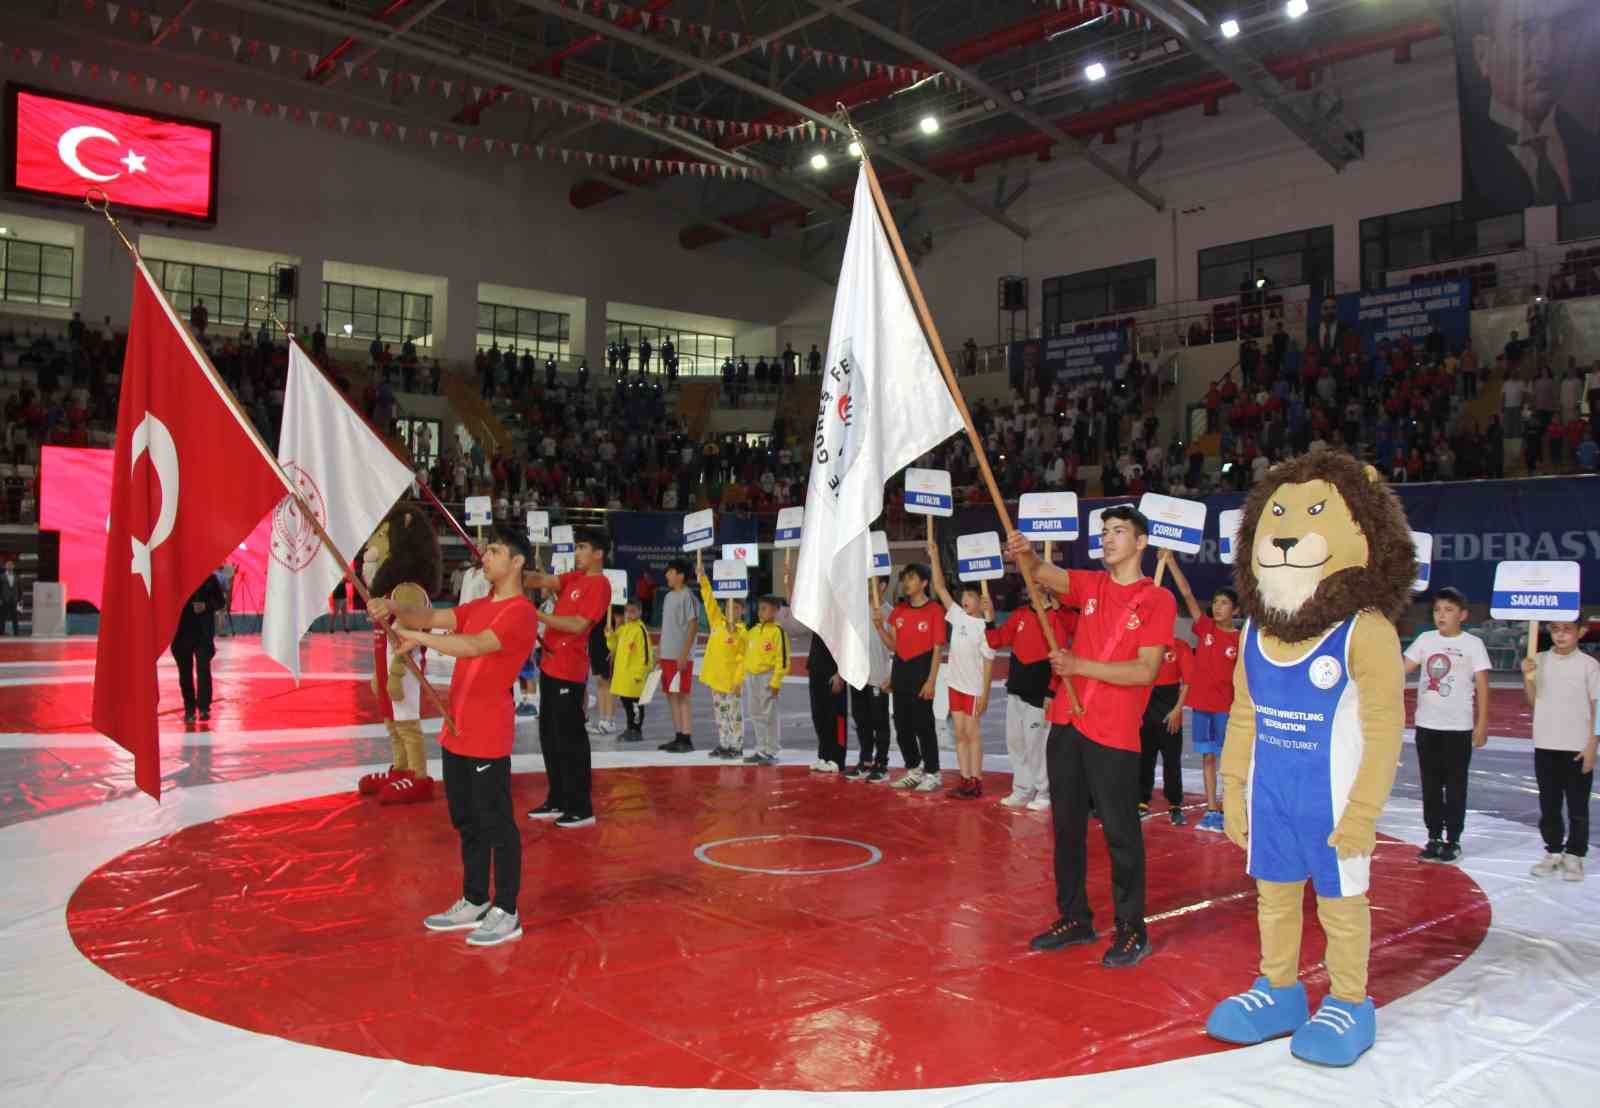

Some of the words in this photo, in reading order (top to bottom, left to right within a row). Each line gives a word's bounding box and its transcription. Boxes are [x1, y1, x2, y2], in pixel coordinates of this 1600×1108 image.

[915, 493, 941, 506] ANTALYA
[1031, 519, 1063, 531] ISPARTA
[1510, 594, 1559, 607] SAKARYA
